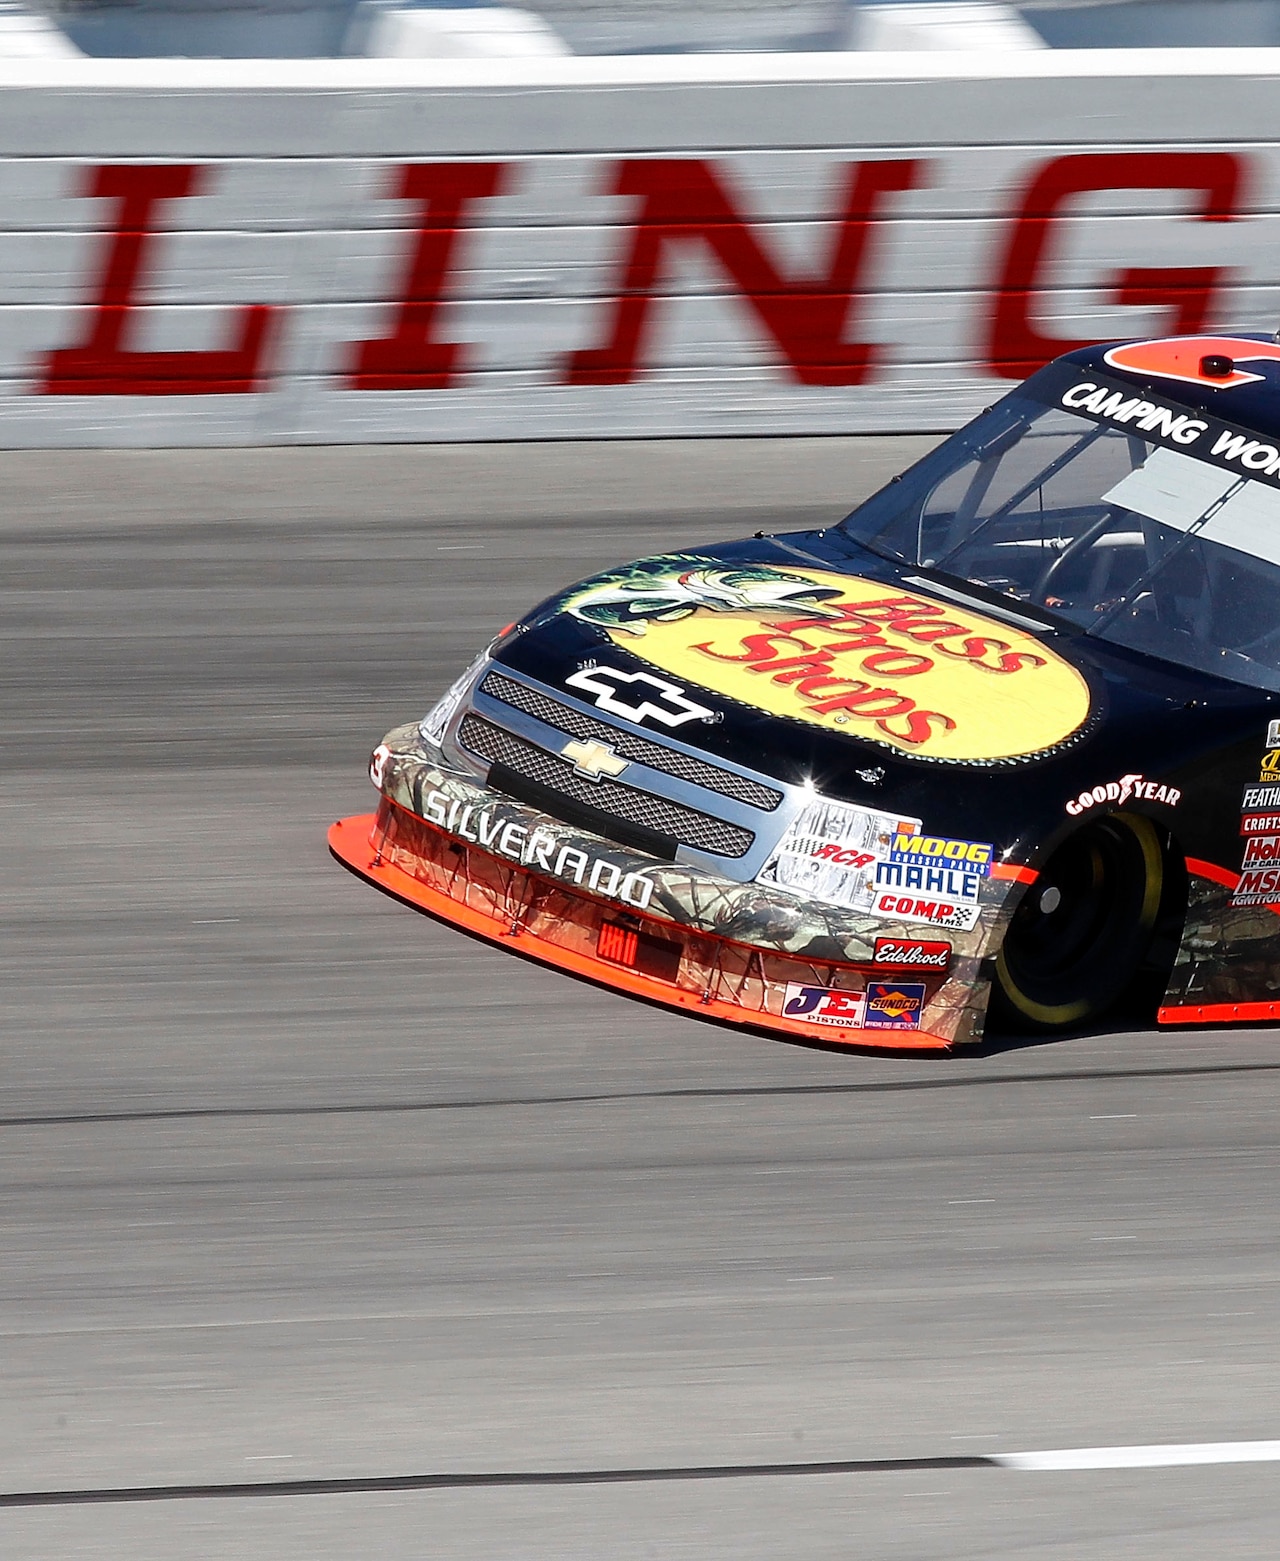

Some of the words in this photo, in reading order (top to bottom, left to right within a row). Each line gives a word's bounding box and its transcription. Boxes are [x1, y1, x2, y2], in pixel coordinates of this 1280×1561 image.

[1061, 381, 1208, 445] CAMPING
[838, 597, 1047, 673] Bass
[695, 635, 956, 744] Shops
[369, 744, 390, 789] 3
[423, 789, 654, 910] SILVERADO
[811, 844, 876, 868] RCR
[892, 834, 991, 863] MOOG
[895, 853, 944, 868] CHASSIS
[950, 859, 986, 874] PARTS
[876, 862, 977, 897] MAHLE
[878, 895, 954, 919] COMP
[875, 944, 948, 967] Edelbrock
[784, 987, 863, 1018] JE
[872, 999, 918, 1009] SUNOCO
[807, 1014, 861, 1027] PISTONS
